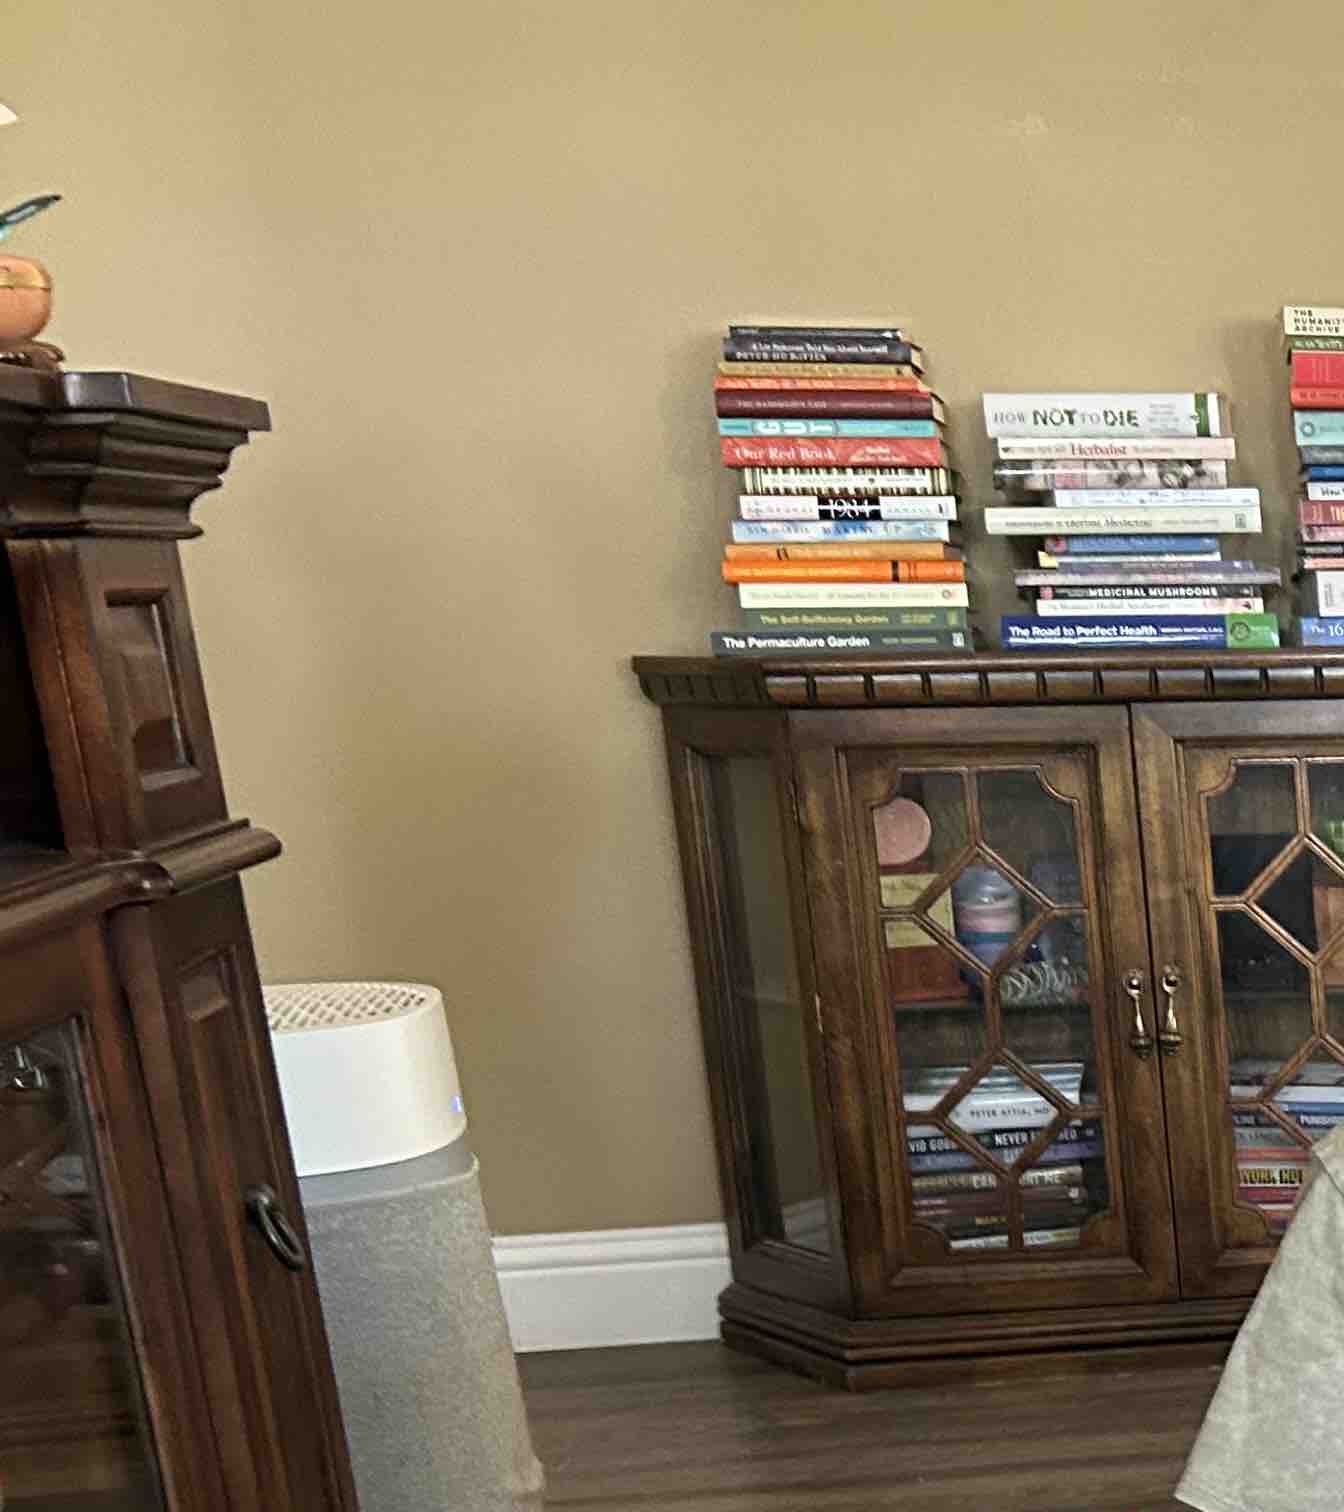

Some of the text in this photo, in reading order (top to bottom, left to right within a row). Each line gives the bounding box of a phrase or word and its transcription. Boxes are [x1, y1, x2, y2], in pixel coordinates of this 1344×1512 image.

[993, 409, 1025, 425] HOW
[1032, 408, 1079, 427] NOT
[1081, 411, 1101, 425] TO
[1103, 409, 1139, 427] DIE
[1009, 624, 1158, 638] The Road to Perfect Health
[723, 636, 746, 649] The
[749, 636, 825, 649] Permaculture
[828, 636, 870, 649] Garden
[994, 1130, 1028, 1146] NEVER
